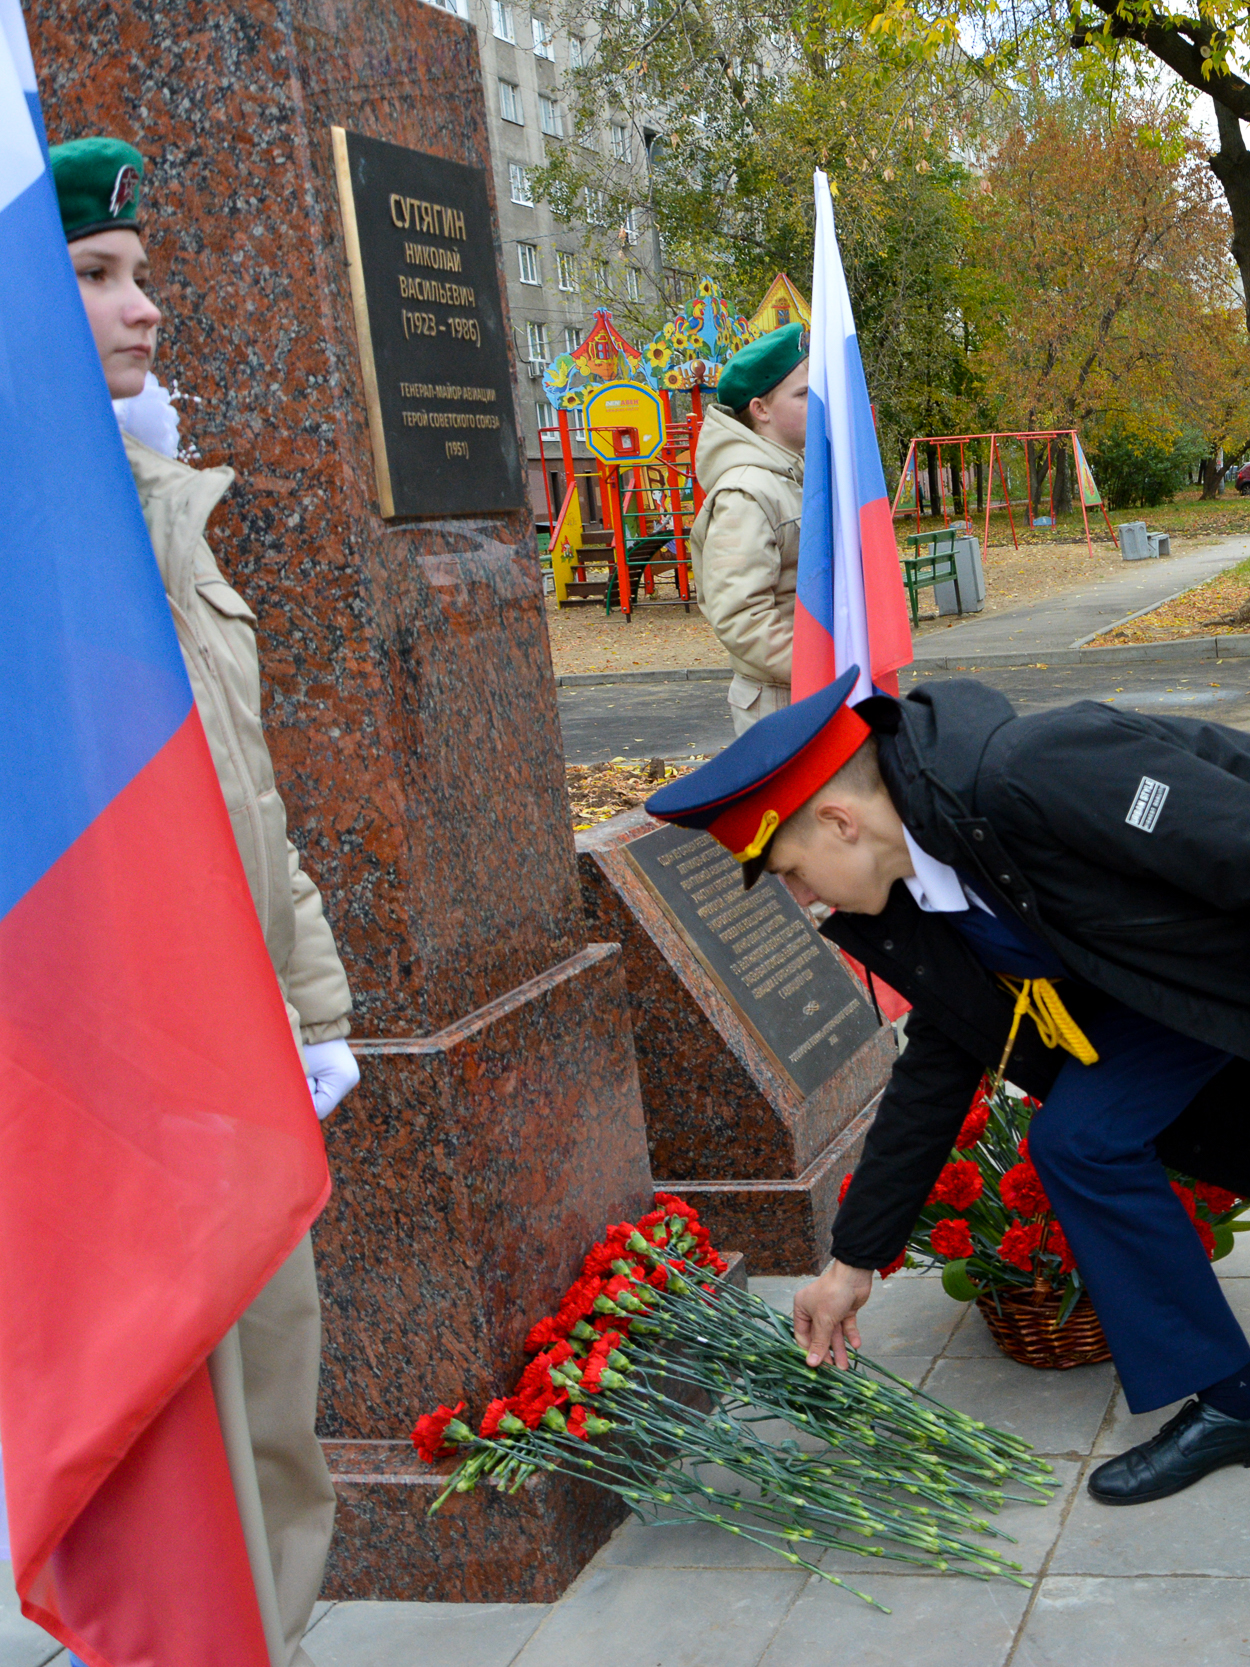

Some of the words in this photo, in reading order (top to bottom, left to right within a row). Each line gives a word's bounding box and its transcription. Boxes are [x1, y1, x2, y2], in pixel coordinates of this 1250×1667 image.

[390, 193, 466, 241] СУТЯГИН
[404, 241, 462, 272] НИКОЛАЙ
[398, 275, 475, 307] ВАСИЛЬЕВИЧ
[402, 309, 437, 340] (1923
[448, 317, 481, 348] 1986)
[400, 382, 462, 400] ГЕНЕРАЛ-МАЙОР
[463, 386, 496, 403] АВИАЦИИ
[402, 409, 428, 427] ГЕРОЙ
[429, 412, 475, 428] СОВЕТСКОГО
[475, 414, 500, 429] СОЮЗА
[445, 441, 469, 460] (1951)
